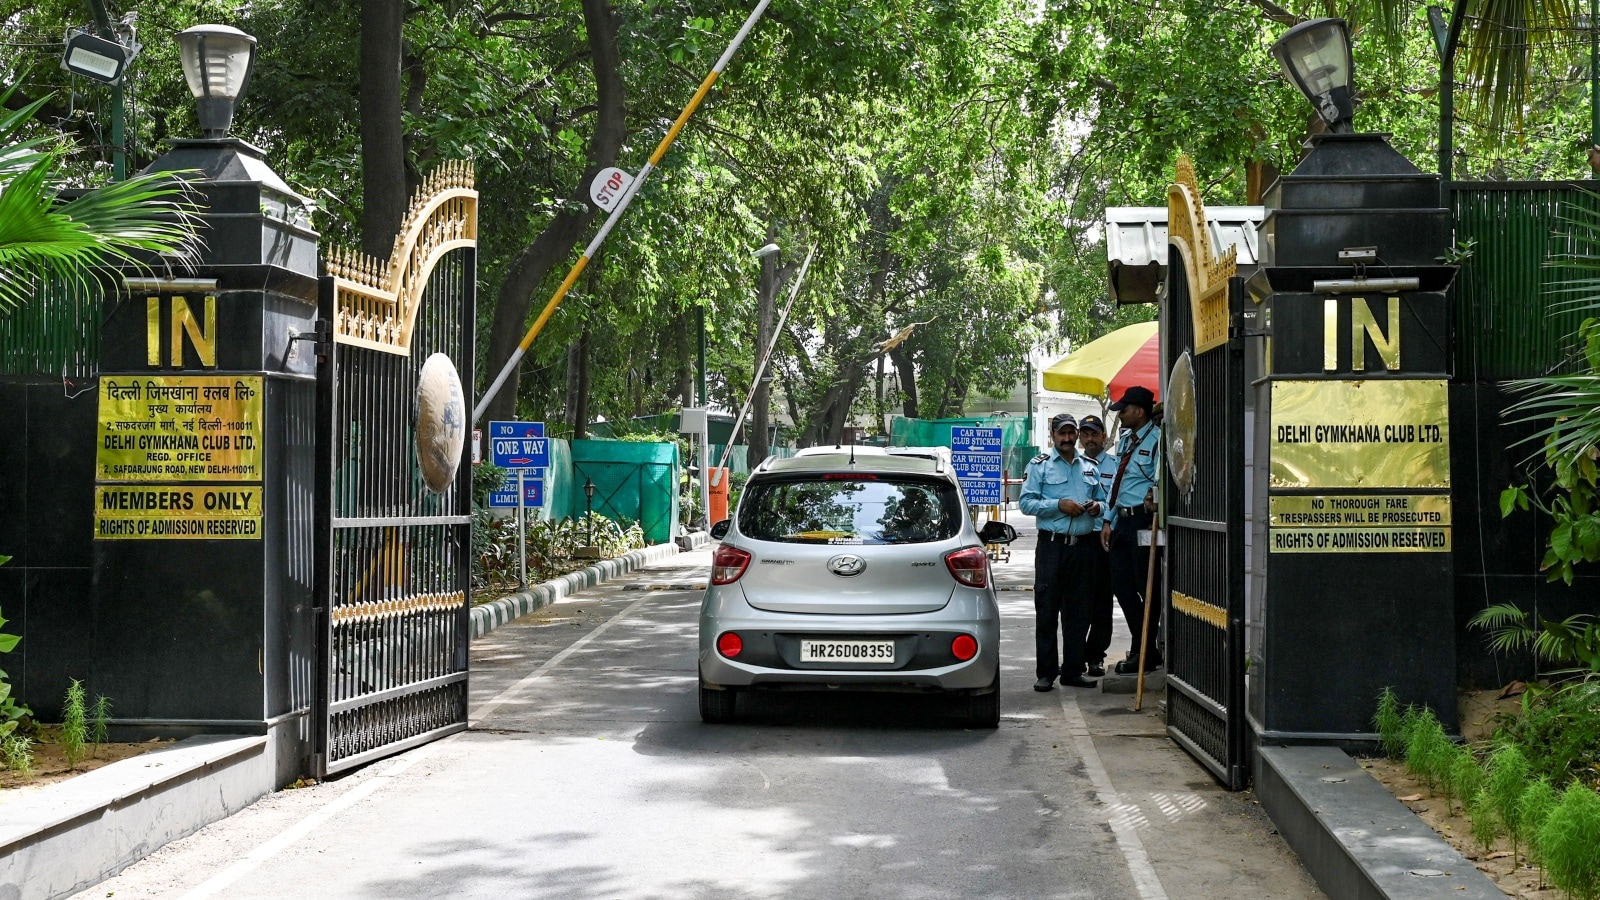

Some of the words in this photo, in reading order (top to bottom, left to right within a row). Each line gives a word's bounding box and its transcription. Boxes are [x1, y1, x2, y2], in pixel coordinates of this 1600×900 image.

[596, 172, 623, 205] STOP
[147, 295, 216, 367] IN
[1324, 297, 1400, 370] IN
[107, 381, 141, 400] दिल्ली
[145, 381, 198, 400] जिमखाना
[203, 386, 230, 400] क्लब
[148, 404, 168, 417] मुख्य
[175, 401, 212, 414] कार्यालय
[182, 420, 194, 432] नई
[500, 426, 514, 434] NO
[960, 429, 974, 437] CAR
[1277, 425, 1311, 443] DELHI
[1315, 425, 1380, 443] GYMKHANA
[1384, 425, 1415, 443] CLUB
[1418, 425, 1443, 443] LTD.
[104, 435, 135, 450] DELHI
[139, 435, 199, 450] GYMKHANA
[202, 435, 230, 450] CLUB
[234, 435, 256, 451] LTD.
[496, 441, 519, 455] ONE
[522, 440, 545, 455] WAY
[952, 437, 969, 445] CLUB
[971, 438, 1001, 446] STICKER
[146, 452, 172, 462] REGD.
[176, 452, 212, 462] OFFICE
[952, 455, 967, 463] CAR
[968, 455, 1001, 464] WITHOUT
[104, 465, 111, 474] 2,
[113, 464, 163, 474] SAFDARJUNG
[165, 465, 188, 475] ROAD,
[188, 465, 206, 474] NEW
[971, 464, 1000, 472] STICKER
[102, 491, 194, 510] MEMBERS
[203, 491, 253, 510] ONLY
[495, 494, 519, 503] LIMIT
[971, 496, 1000, 504] BARRIER
[1311, 499, 1324, 509] NO
[1330, 499, 1380, 509] THOROUGH
[1385, 498, 1408, 509] FARE
[1279, 513, 1342, 523] TRESPASSERS
[1344, 512, 1365, 523] WILL
[1368, 512, 1379, 523] BE
[1382, 512, 1441, 522] PROSECUTED
[100, 519, 135, 535] RIGHTS
[137, 519, 149, 535] OF
[151, 519, 204, 535] ADMISSION
[207, 519, 256, 535] RESERVED
[1275, 533, 1314, 549] RIGHTS
[1317, 533, 1330, 548] OF
[1332, 532, 1389, 548] ADMISSION
[1392, 532, 1446, 548] RESERVED
[810, 644, 893, 658] HR26DQ8359
